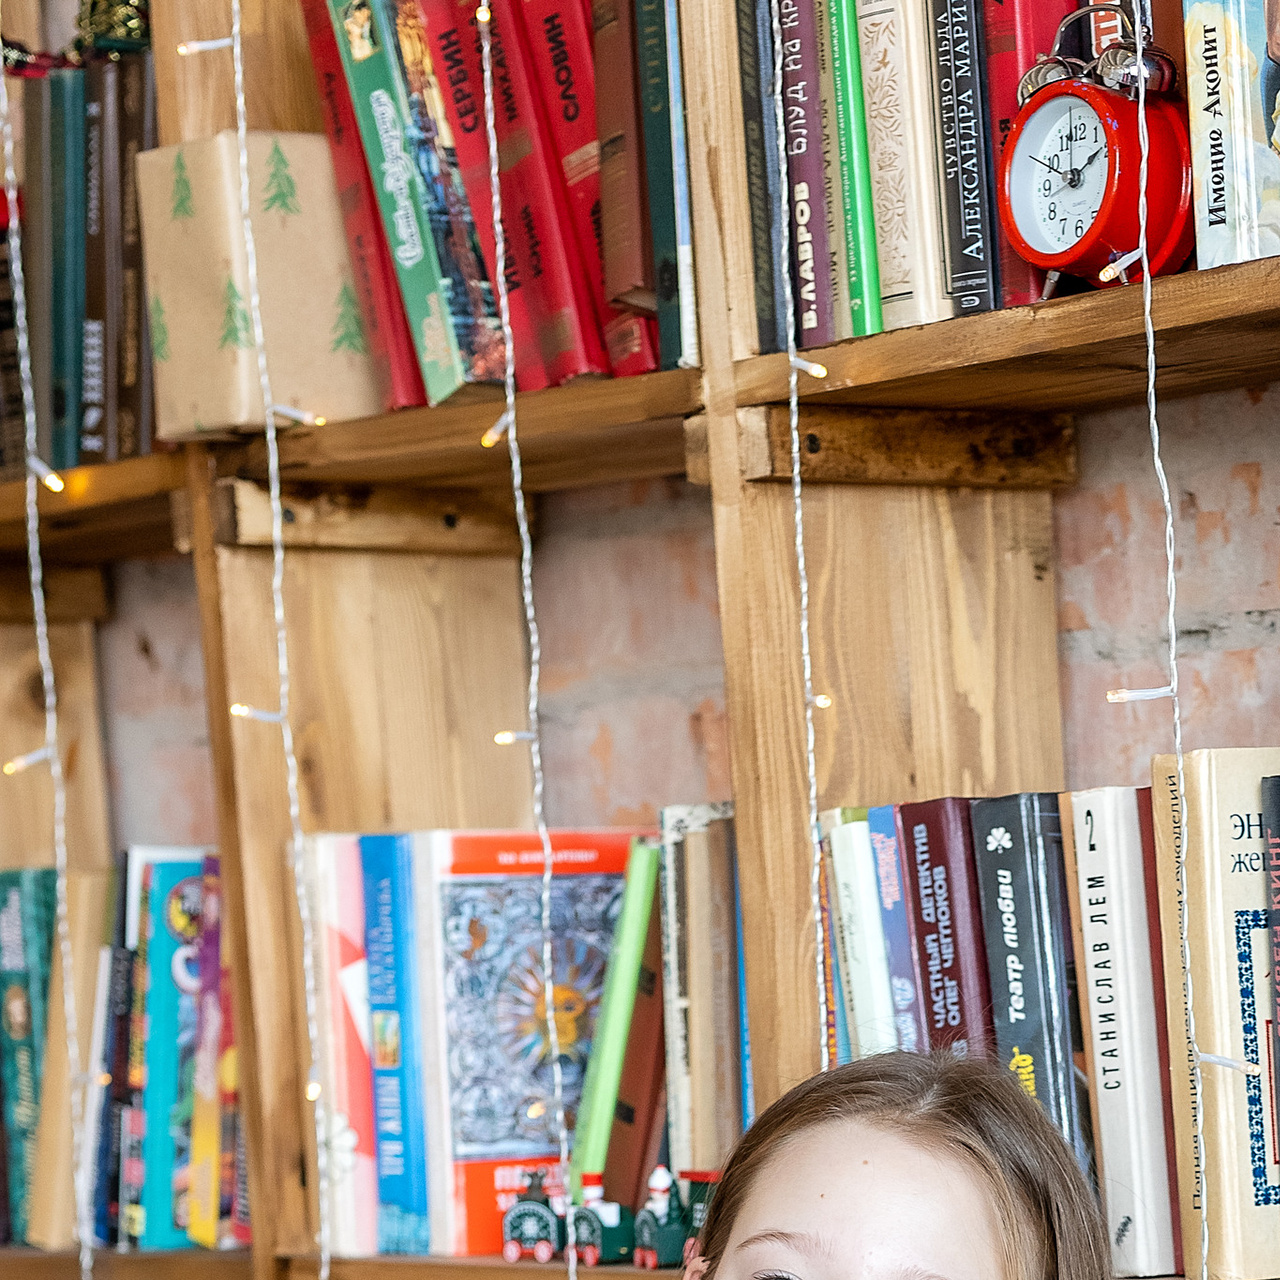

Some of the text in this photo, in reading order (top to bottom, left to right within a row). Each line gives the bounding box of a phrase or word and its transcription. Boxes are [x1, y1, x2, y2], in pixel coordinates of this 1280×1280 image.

[438, 27, 480, 133] СЕРБИН
[543, 13, 580, 122] СЛОВИН
[936, 11, 958, 179] ЧУВСТВО ЛЬДА
[1073, 123, 1086, 142] 12
[957, 90, 985, 261] АЛЕКСАНДРА
[1043, 180, 1052, 198] 9
[1048, 202, 1057, 220] 8
[1059, 218, 1067, 235] 7
[1075, 219, 1084, 238] 6
[1085, 808, 1098, 852] 2
[913, 823, 946, 1028] ЧАСТНЫЙ ДЕТЕКТИВ
[997, 868, 1019, 948] любви
[943, 979, 961, 1027] ОЛЕГ
[1005, 953, 1026, 1024] Театр
[1087, 874, 1121, 1090] СТАНИСЛАВ ЛЕМ
